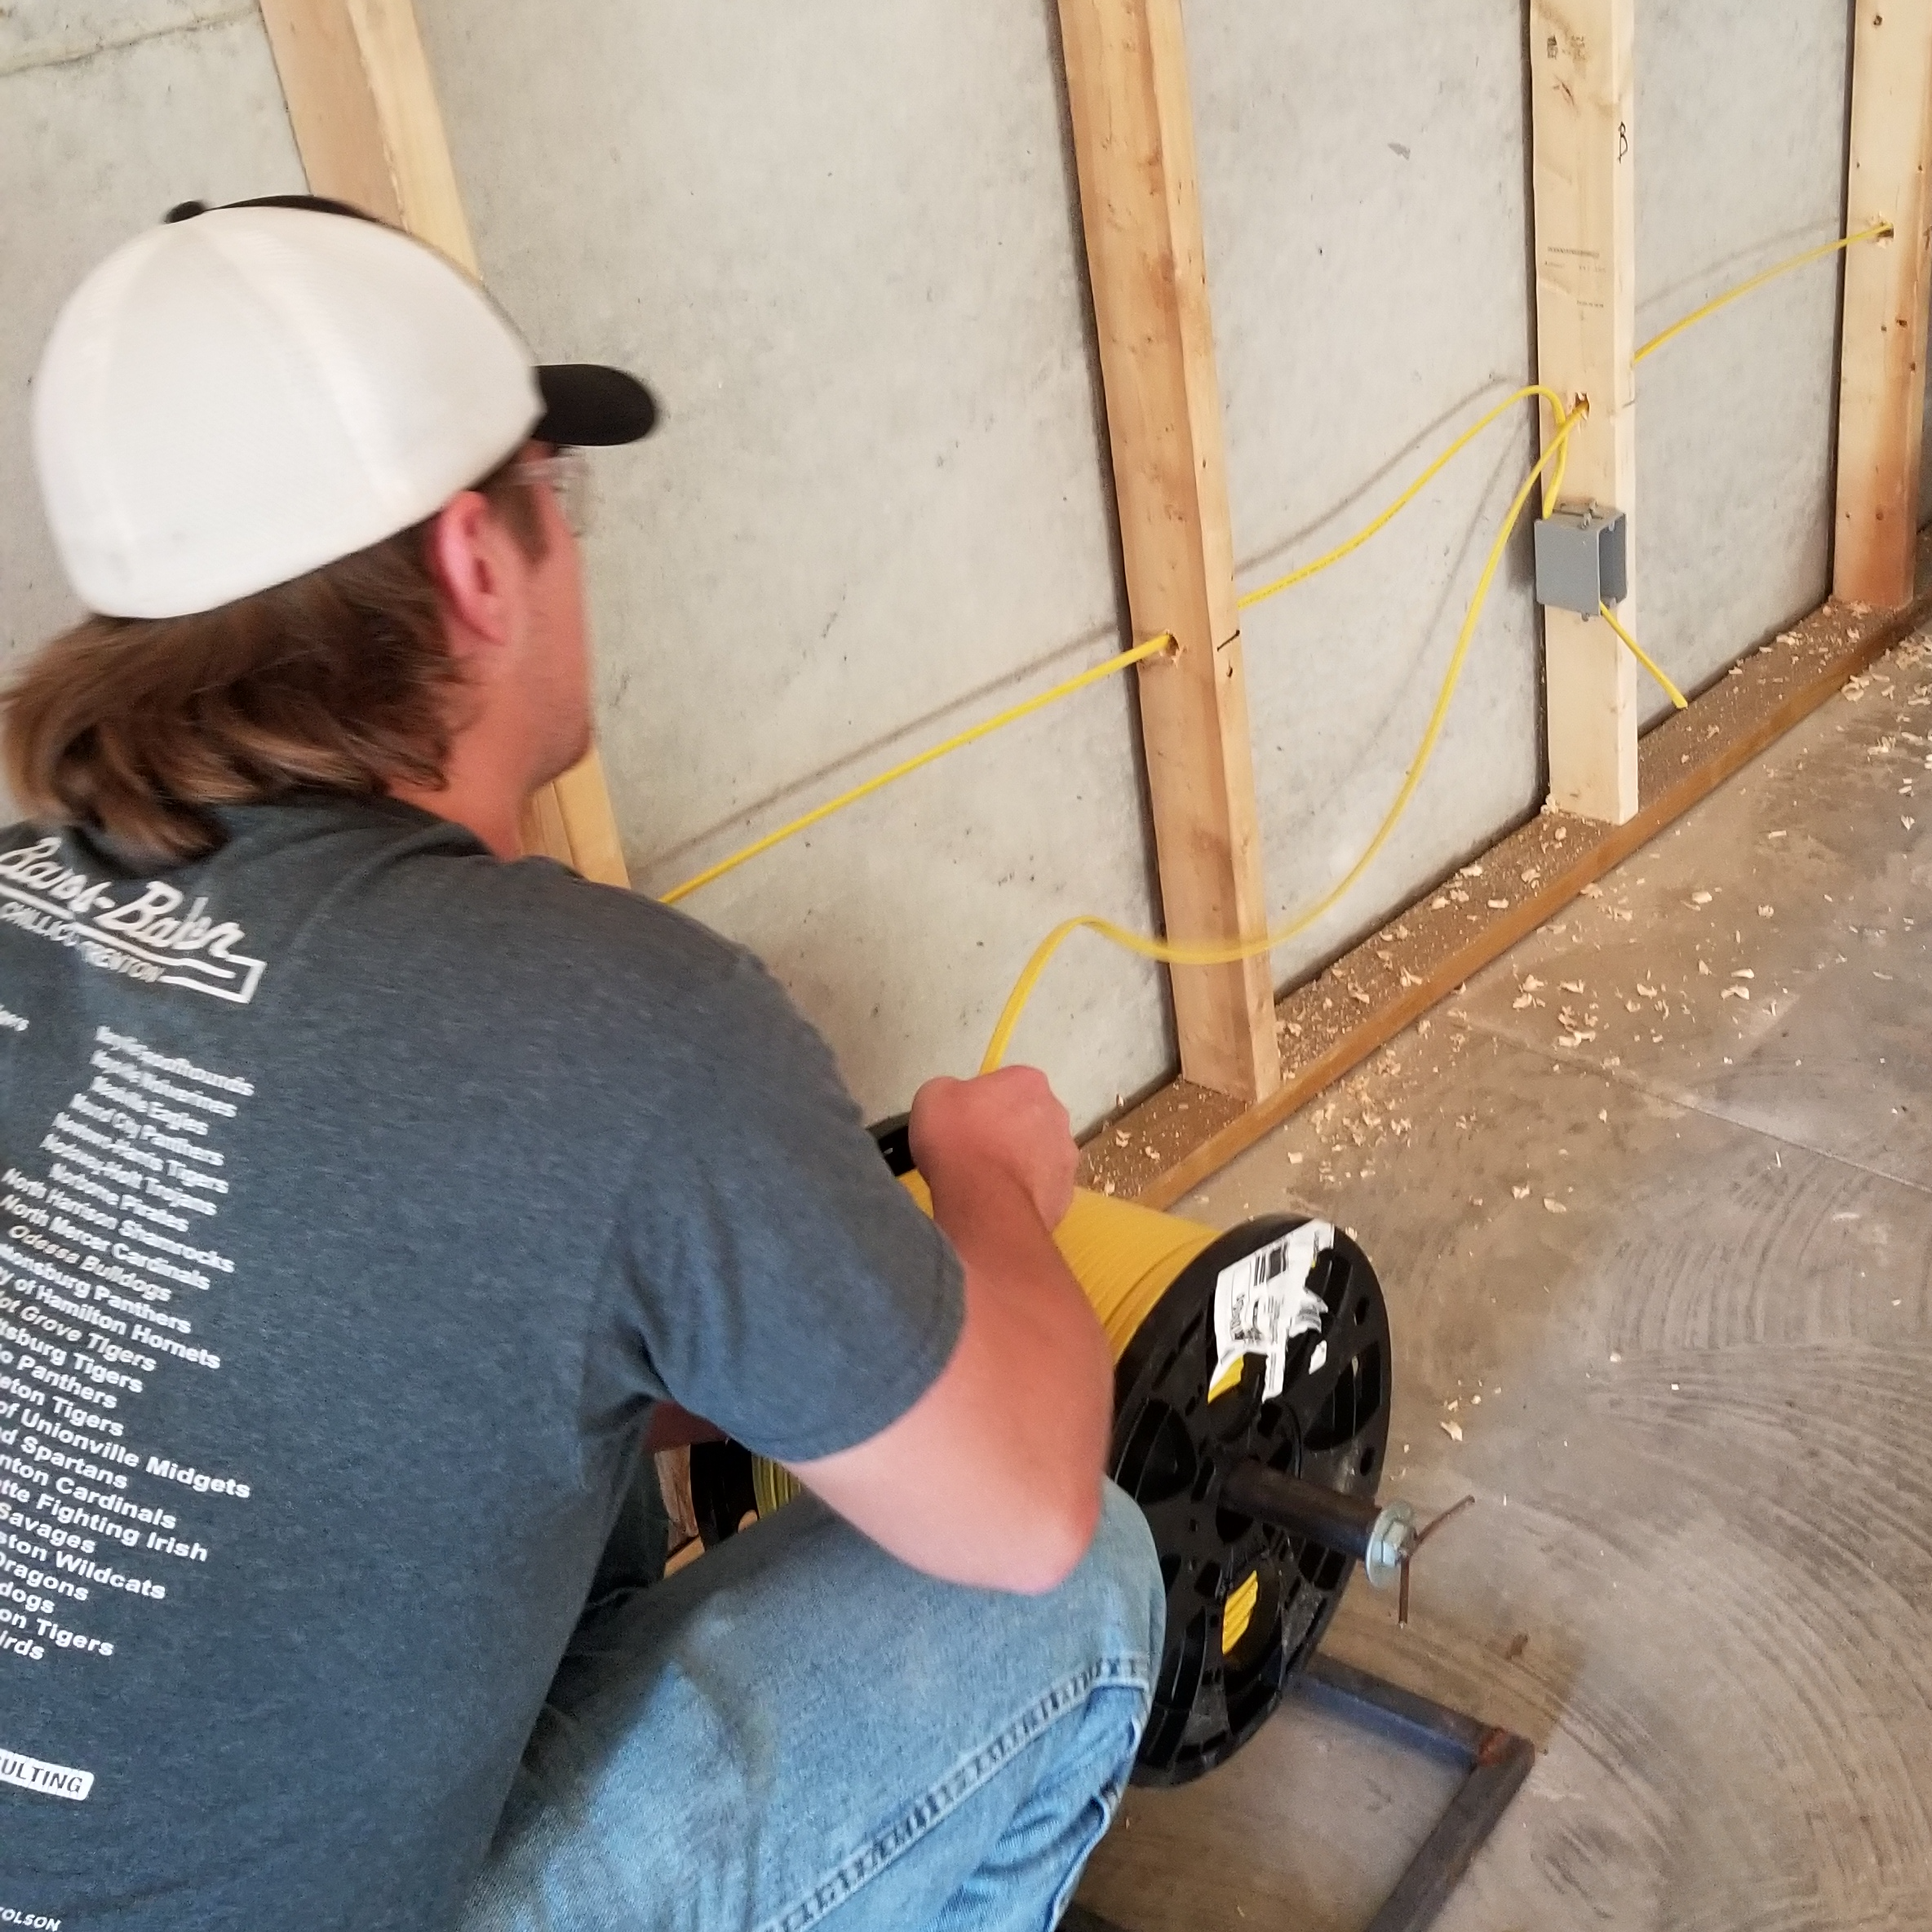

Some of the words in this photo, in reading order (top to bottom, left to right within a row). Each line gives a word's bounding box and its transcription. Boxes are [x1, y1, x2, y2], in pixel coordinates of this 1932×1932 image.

[8, 1225, 80, 1264] Odessa
[78, 1256, 171, 1301] Bulldogs
[0, 1291, 21, 1313] ot
[20, 1305, 82, 1341] Grove
[87, 1332, 157, 1371] Tigers
[14, 1278, 37, 1295] of
[35, 1285, 127, 1335] Hamilton
[131, 1324, 220, 1370] Hornets
[93, 1285, 192, 1334] Panthers
[16, 1354, 117, 1409] Panthers
[73, 1352, 144, 1393] Tigers
[52, 1395, 124, 1437] Tigers
[20, 1408, 140, 1467] Unionville
[145, 1456, 250, 1498] Midgets
[20, 1436, 128, 1489] Spartans
[0, 1502, 96, 1553] Savages
[36, 1493, 140, 1546] Fighting
[146, 1531, 208, 1562] Irish
[55, 1477, 176, 1529] Cardinals
[55, 1550, 166, 1600] Wildcats
[37, 1618, 114, 1656] Tigers
[0, 1907, 62, 1931] OLSON
